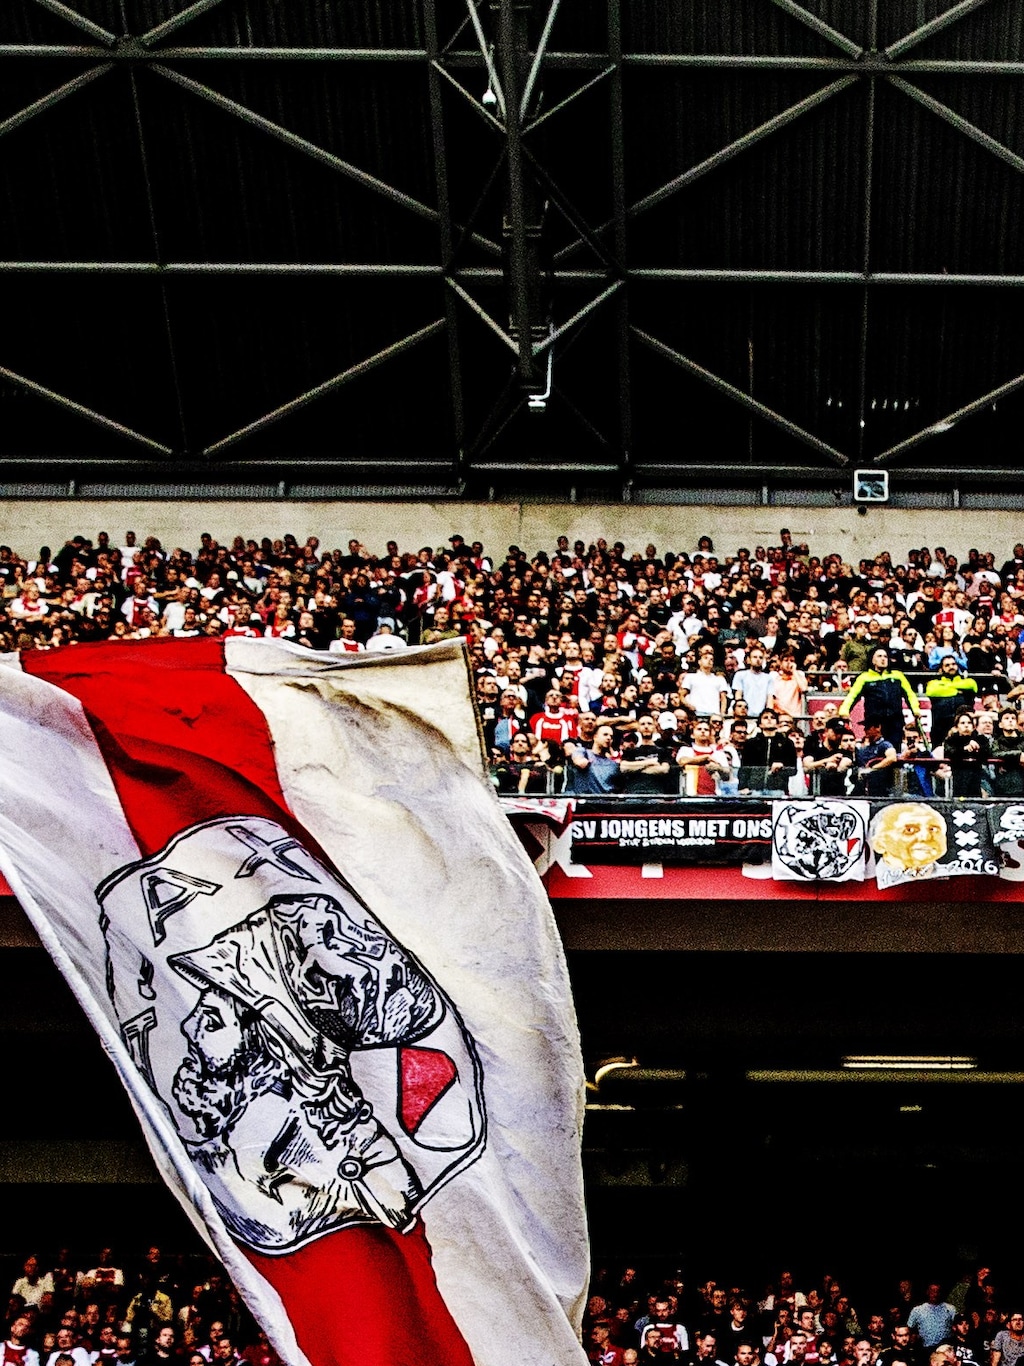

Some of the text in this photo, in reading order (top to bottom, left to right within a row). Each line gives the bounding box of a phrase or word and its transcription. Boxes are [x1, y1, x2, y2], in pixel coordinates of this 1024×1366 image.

[600, 819, 685, 838] JONGENS
[688, 819, 729, 837] MET
[732, 820, 773, 838] ONS
